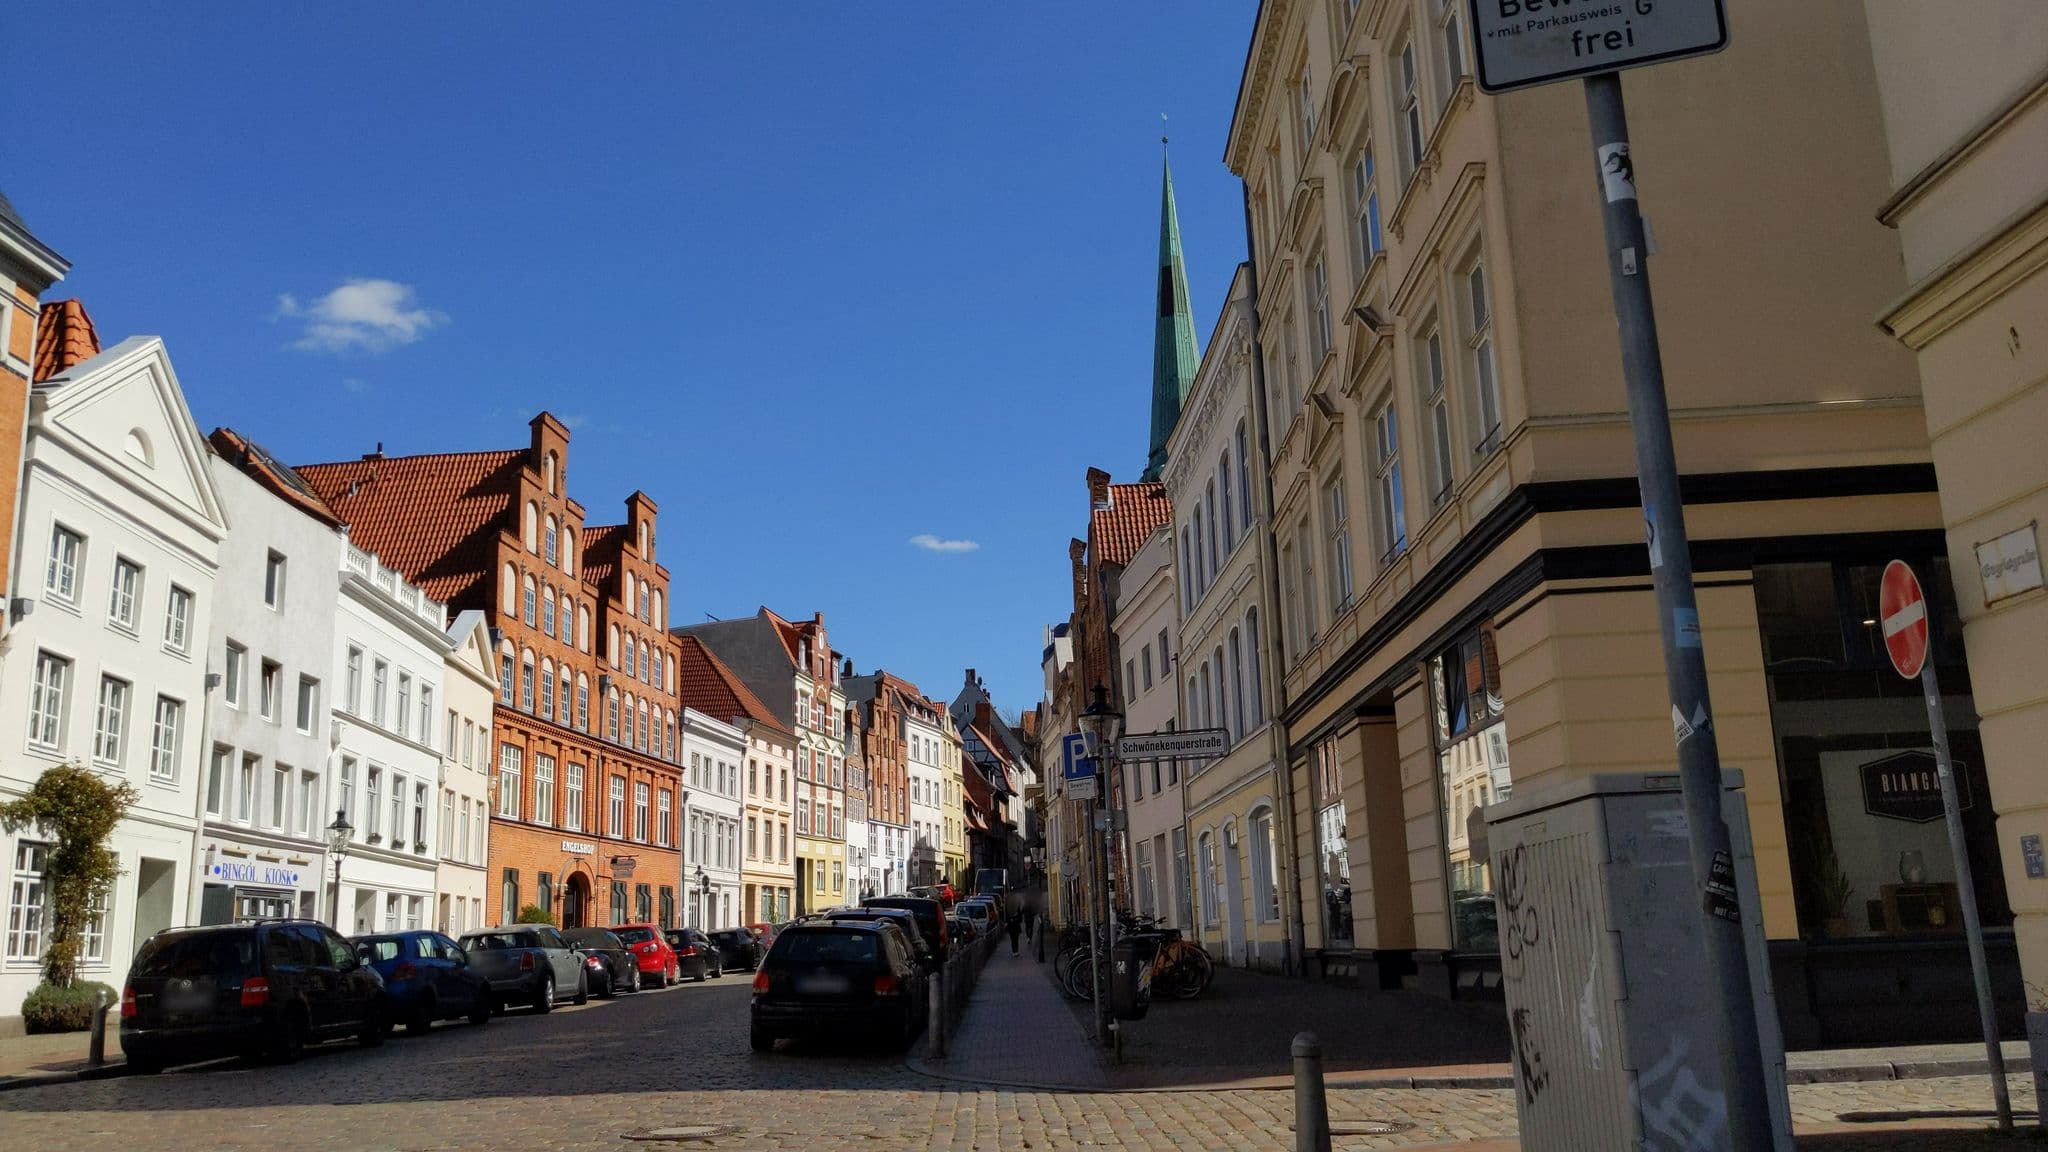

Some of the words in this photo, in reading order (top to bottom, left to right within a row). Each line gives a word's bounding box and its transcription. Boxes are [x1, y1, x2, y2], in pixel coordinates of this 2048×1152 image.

[1527, 5, 1622, 31] Parkausweis
[1571, 20, 1634, 57] frei
[1122, 736, 1222, 754] Schwönekenquerstraße
[265, 867, 293, 886] KIOSK
